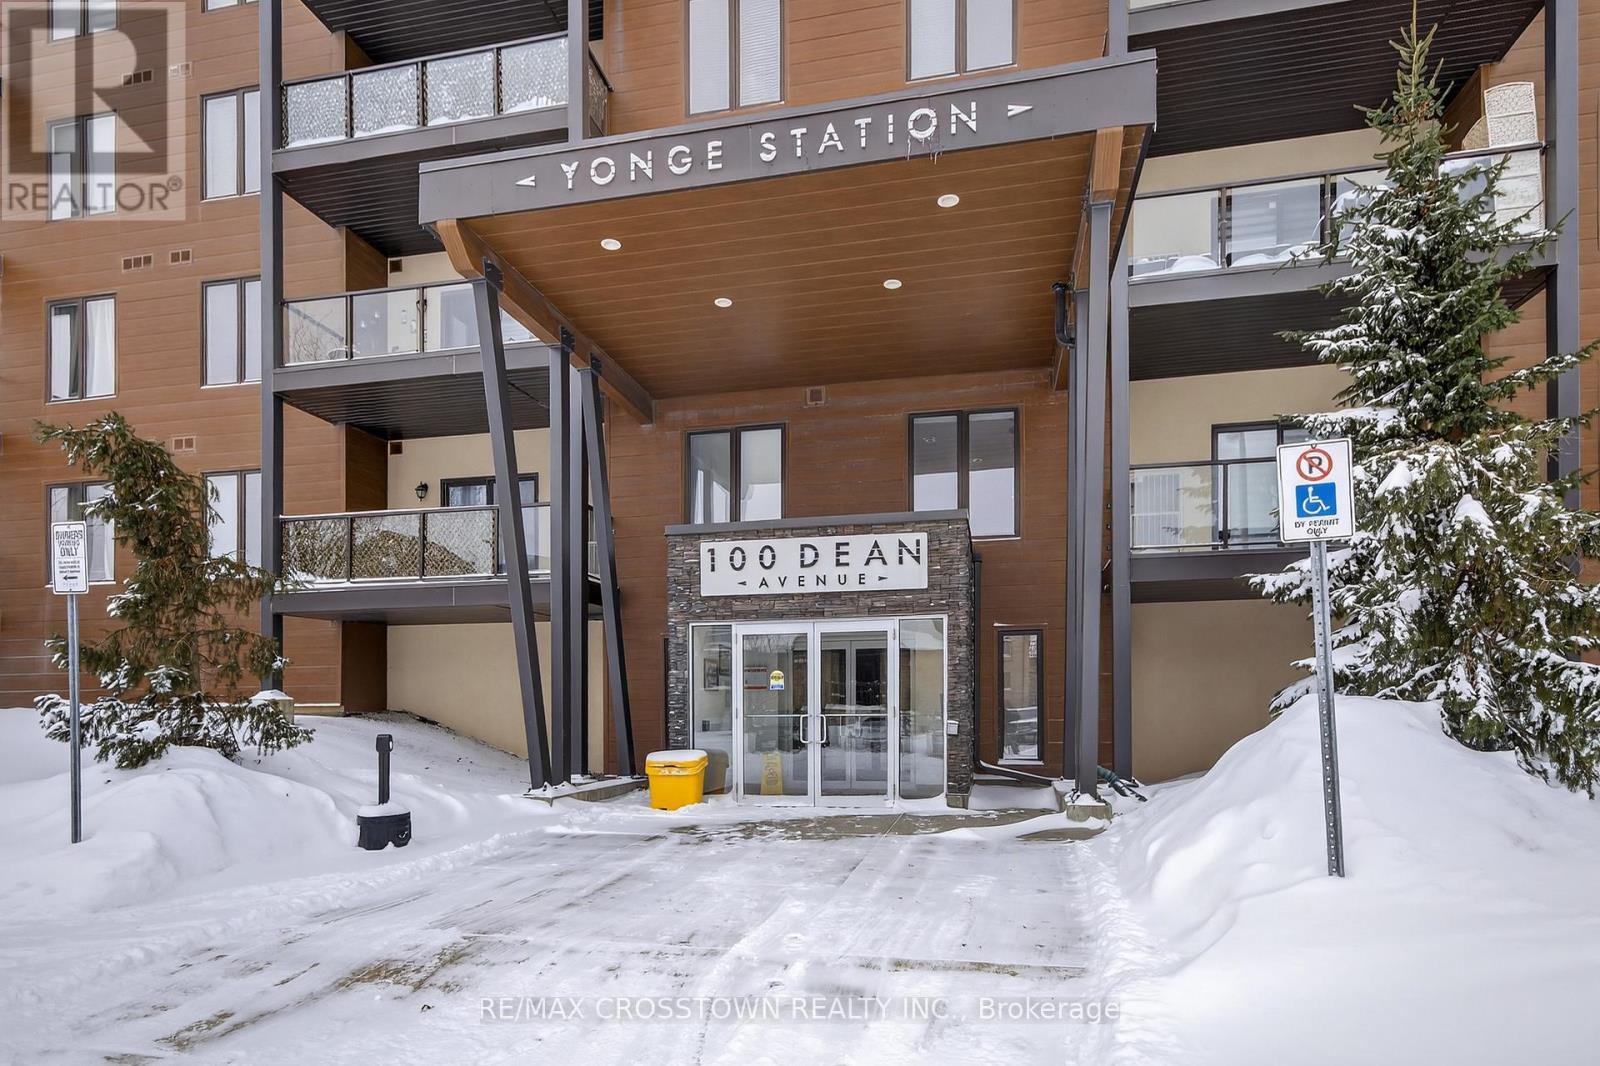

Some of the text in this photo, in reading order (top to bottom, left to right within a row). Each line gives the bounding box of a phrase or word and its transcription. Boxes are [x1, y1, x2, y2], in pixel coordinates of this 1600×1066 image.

[560, 101, 977, 190] YONGE STATION
[60, 547, 78, 556] ONLY
[707, 538, 921, 572] 100 DEAN
[758, 573, 866, 588] AVENUE
